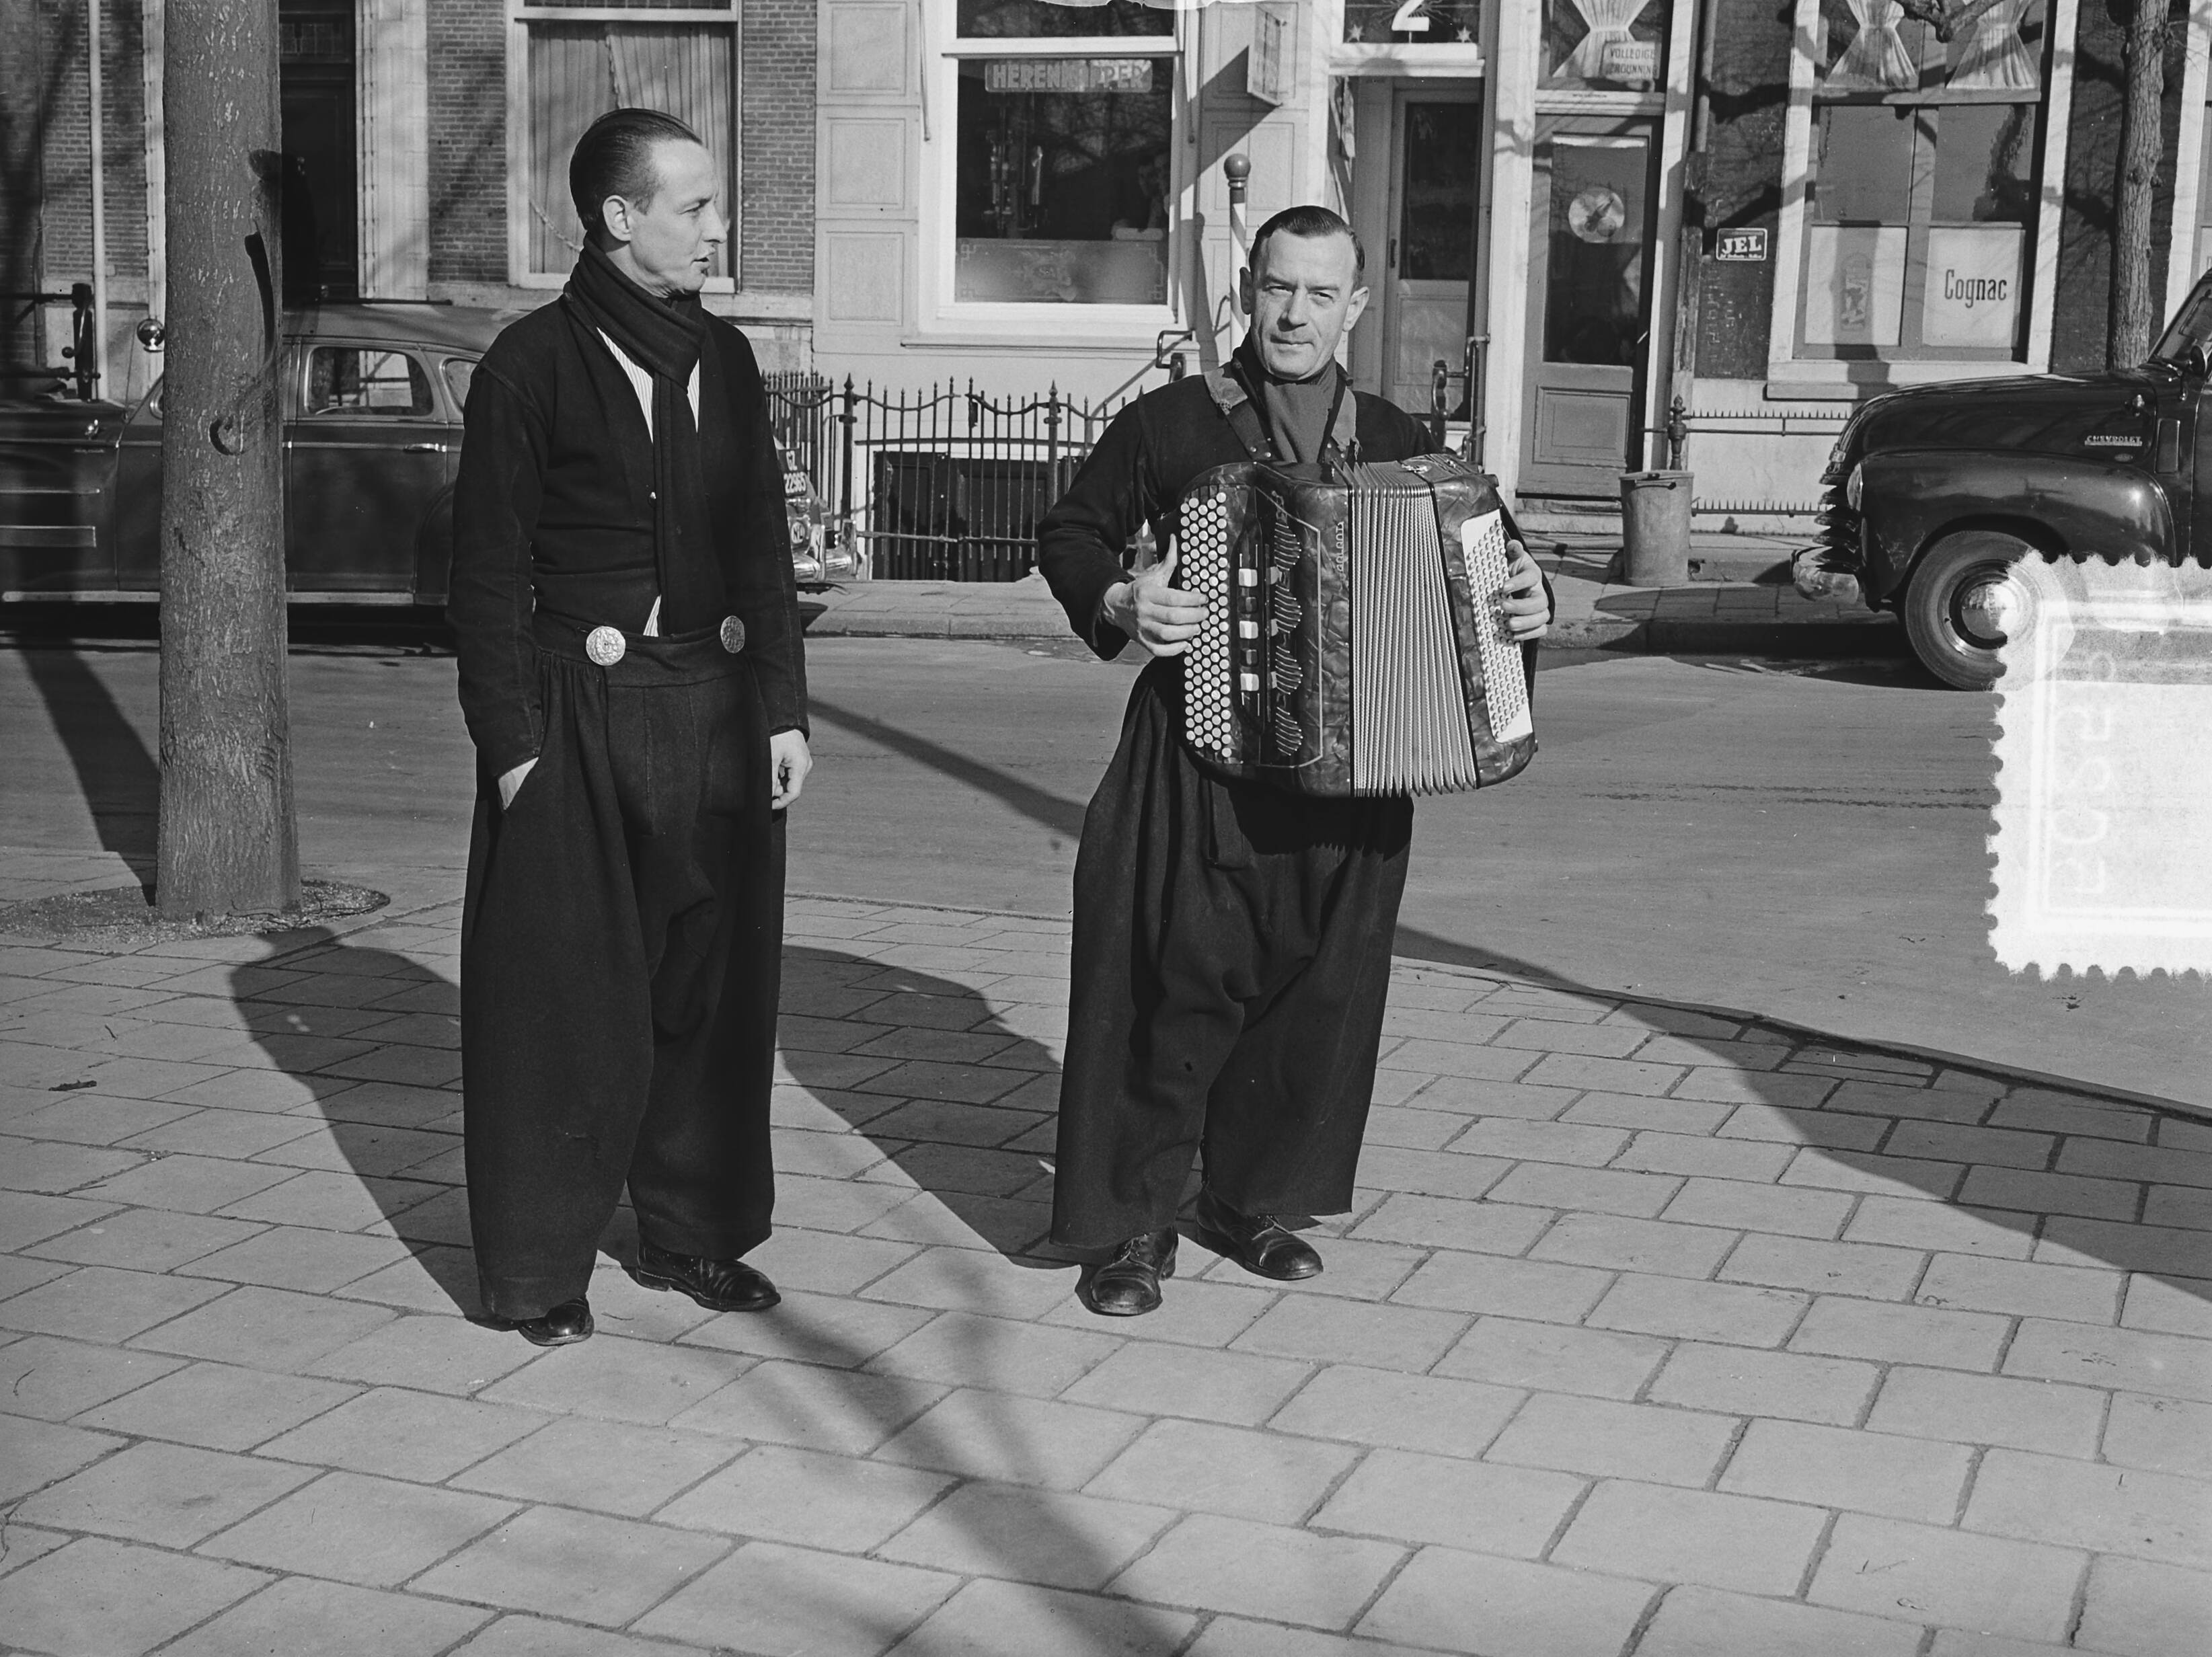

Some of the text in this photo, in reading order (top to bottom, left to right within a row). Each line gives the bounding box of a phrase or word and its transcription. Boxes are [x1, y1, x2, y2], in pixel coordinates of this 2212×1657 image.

[1610, 48, 1654, 60] VOLLEDIGE
[1722, 235, 1762, 255] JEL
[1944, 269, 2007, 309] Cognac
[2086, 435, 2141, 444] CHEVROLET
